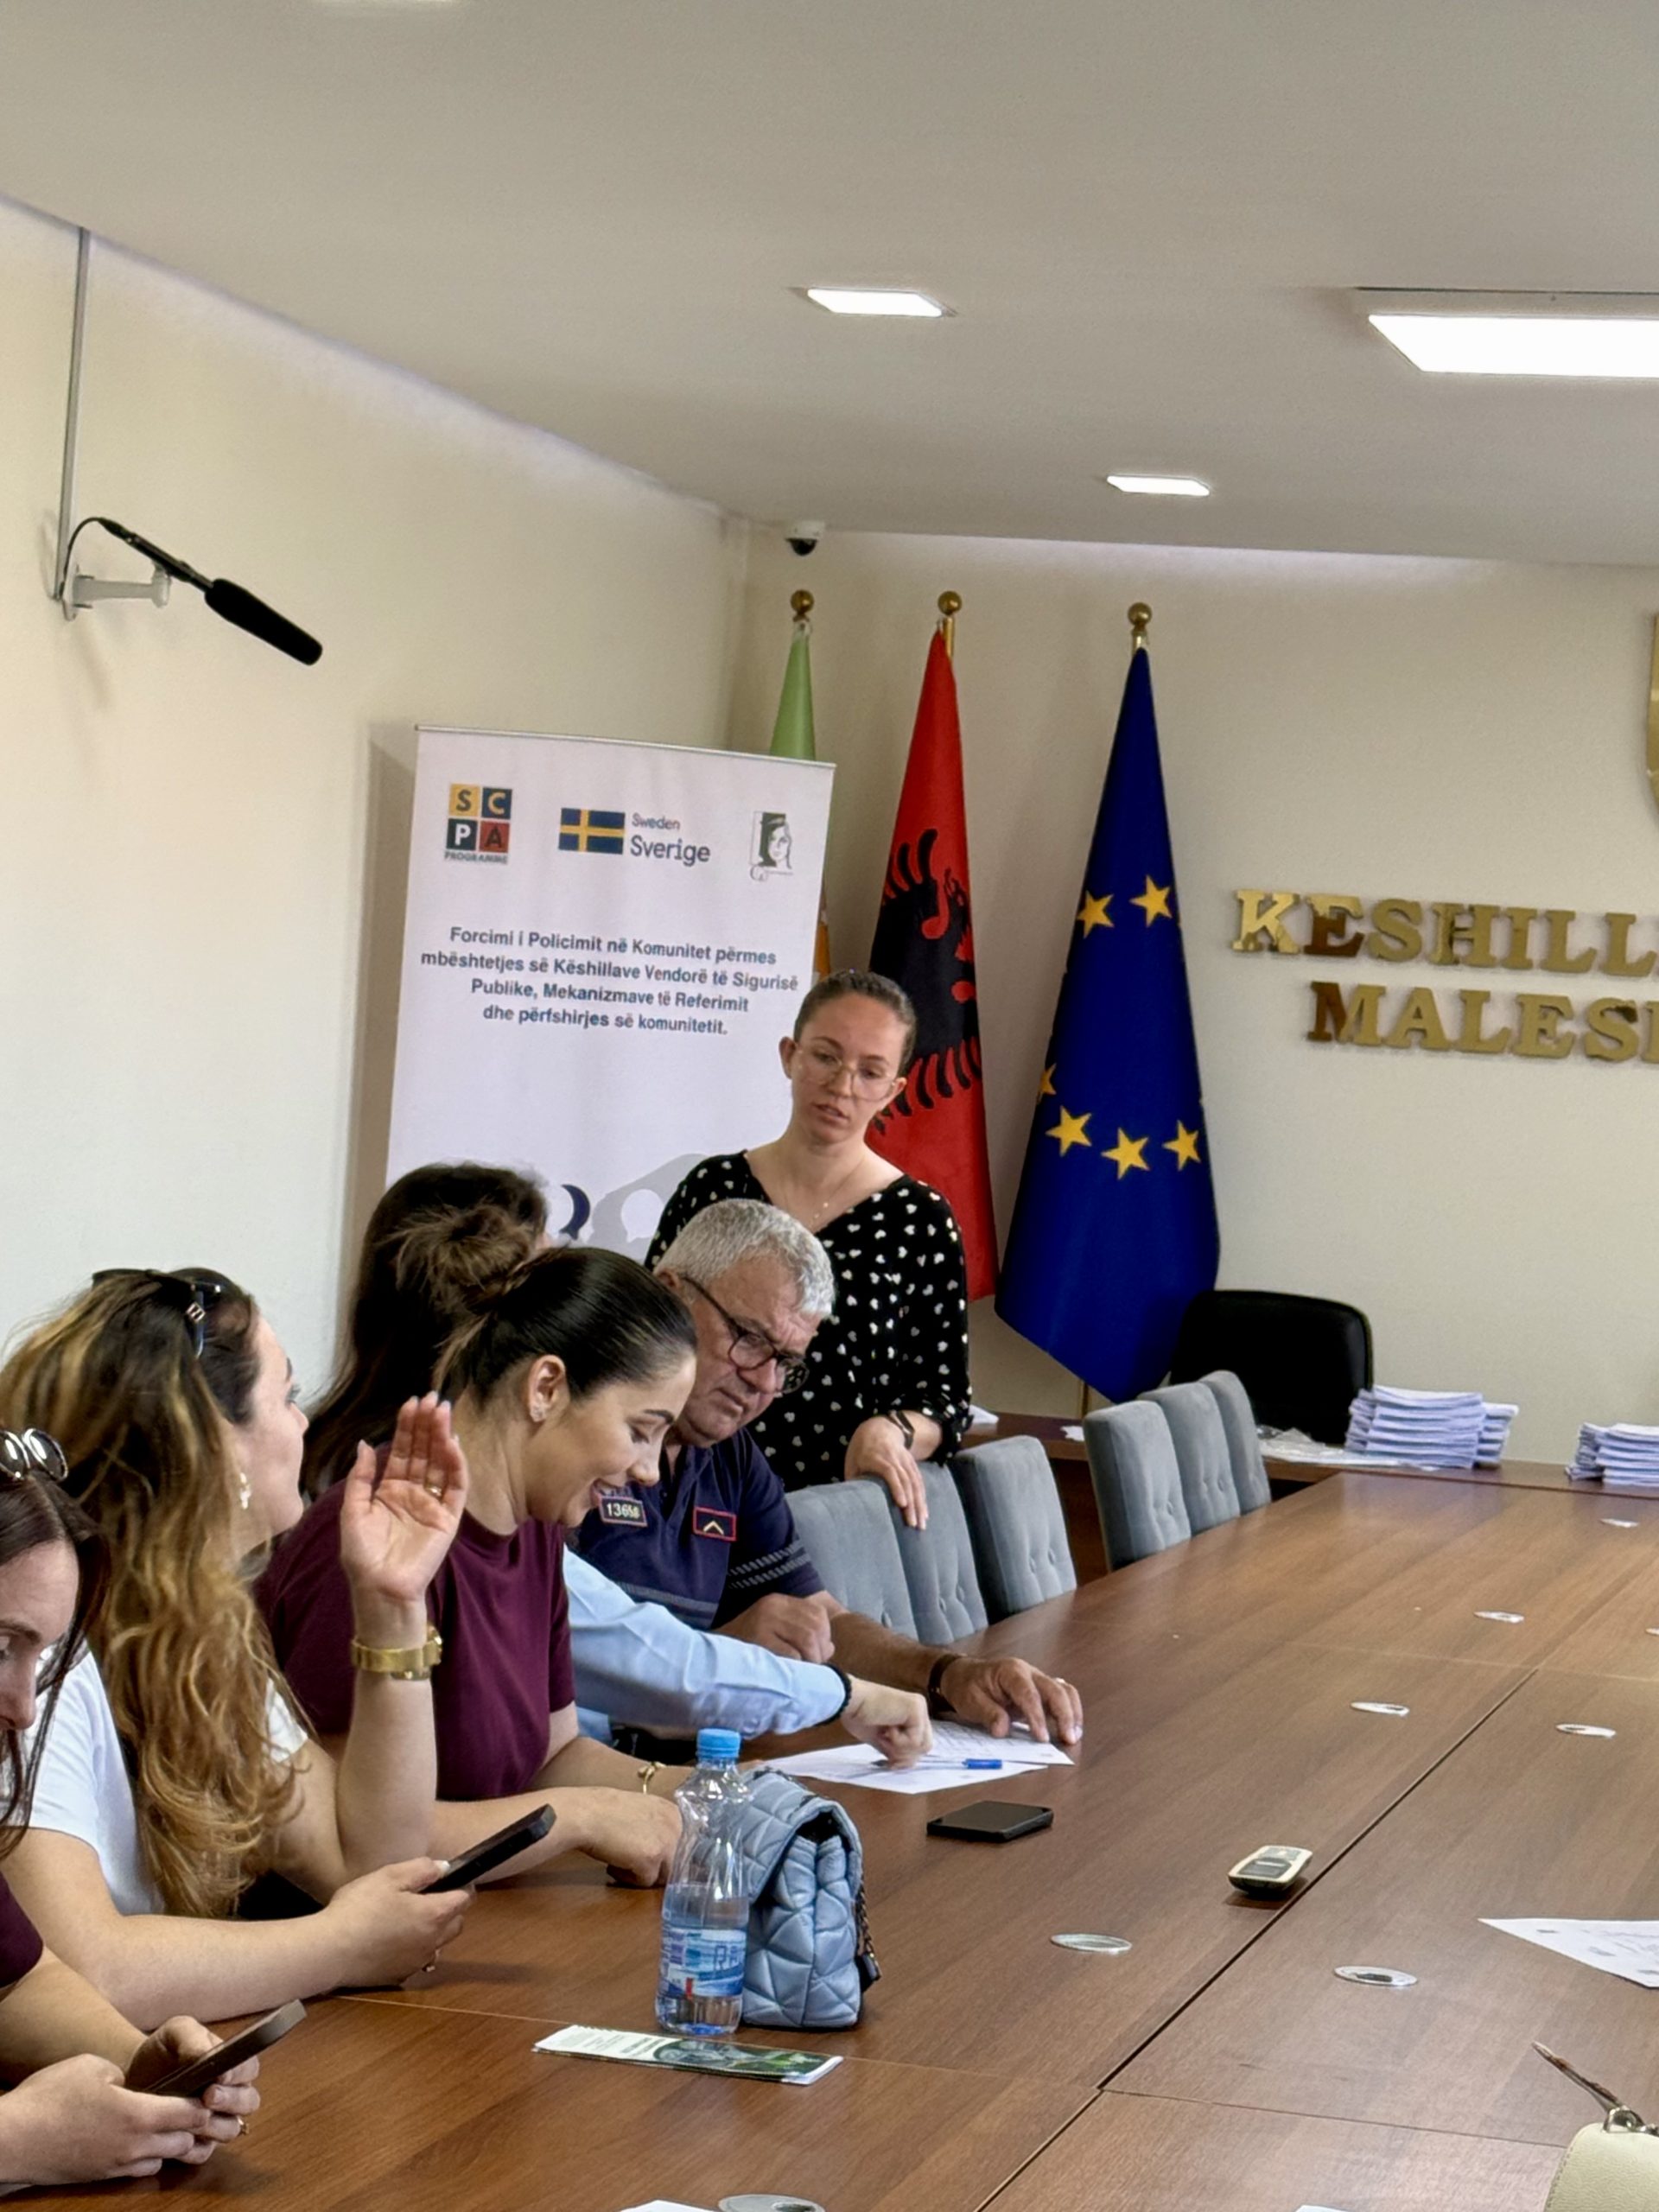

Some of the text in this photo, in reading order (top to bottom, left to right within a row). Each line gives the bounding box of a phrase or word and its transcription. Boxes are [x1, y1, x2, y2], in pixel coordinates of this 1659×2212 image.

[632, 812, 680, 830] Sweden
[444, 850, 508, 864] PROGRAMME
[631, 835, 710, 867] Sverige
[450, 926, 777, 965] Forcimi i Policimit në Komunitet përmes
[421, 951, 798, 992] mbështetjes së Këshillave Vendorë të Sigurisë
[472, 978, 749, 1013] Publike, Mekanizmave të Referimit
[483, 1005, 728, 1035] dhe përfshirjes së komunitetit.
